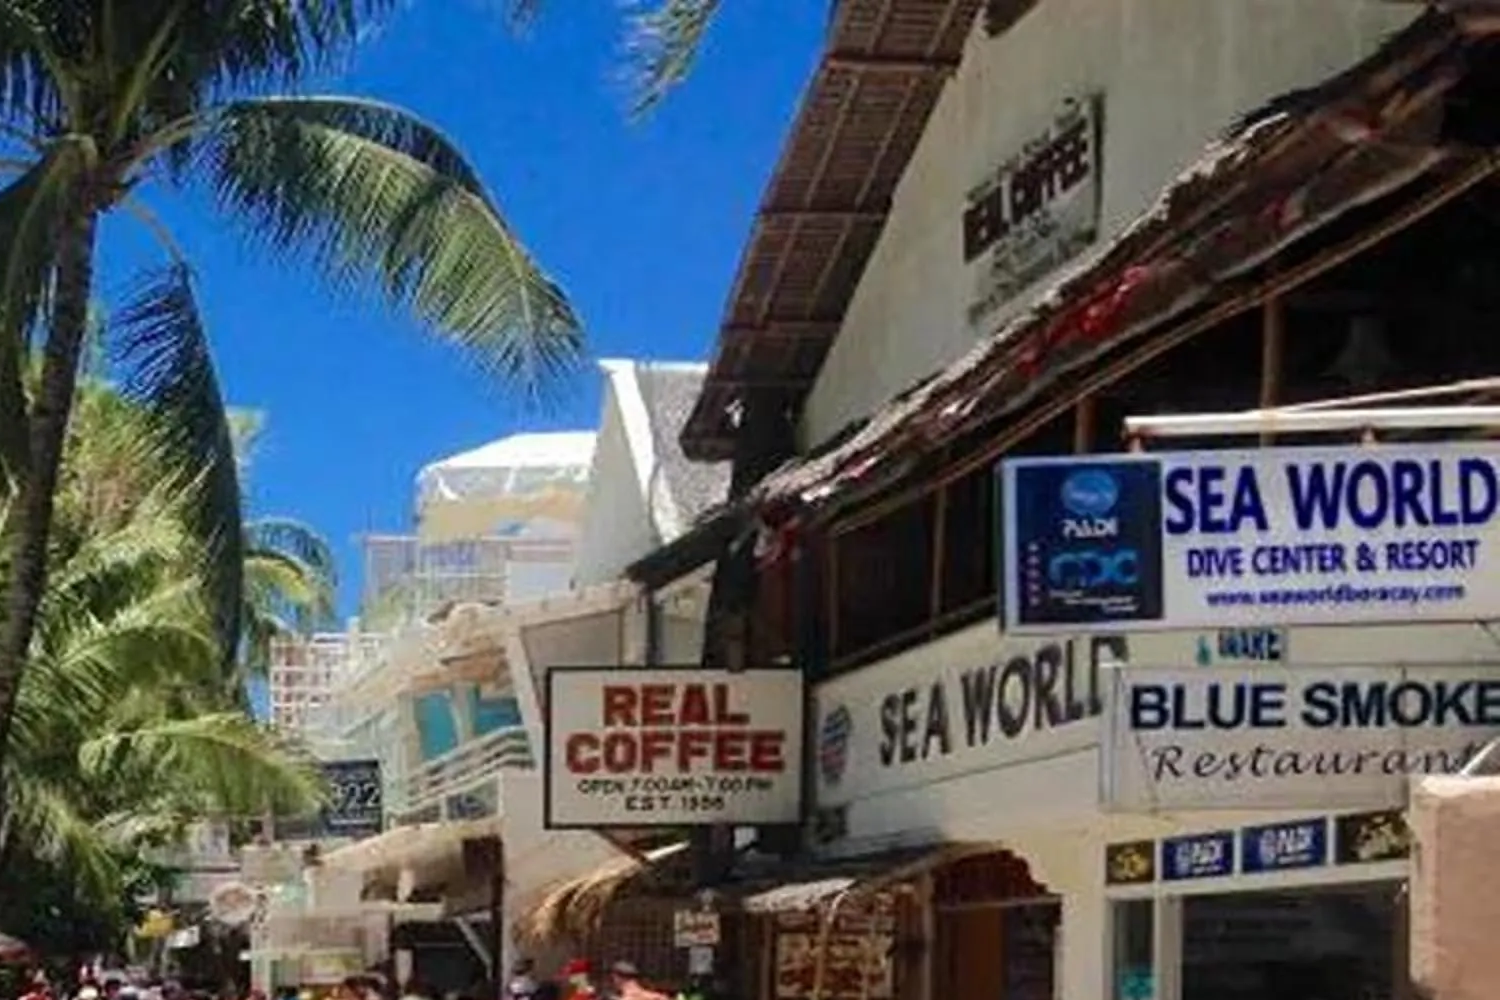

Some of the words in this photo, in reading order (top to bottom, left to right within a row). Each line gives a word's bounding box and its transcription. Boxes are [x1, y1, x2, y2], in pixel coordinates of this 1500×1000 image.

[1165, 466, 1268, 535] SEA
[1286, 457, 1498, 530] WORLD
[1187, 548, 1243, 577] DIVE
[1252, 543, 1346, 575] CENTER
[1355, 543, 1377, 572] &
[1386, 539, 1480, 571] RESORT
[602, 683, 750, 726] REAL
[879, 687, 951, 767] SEA
[1130, 683, 1287, 730] BLUE
[1300, 680, 1500, 728] SMOKE
[565, 731, 785, 774] COFFEE
